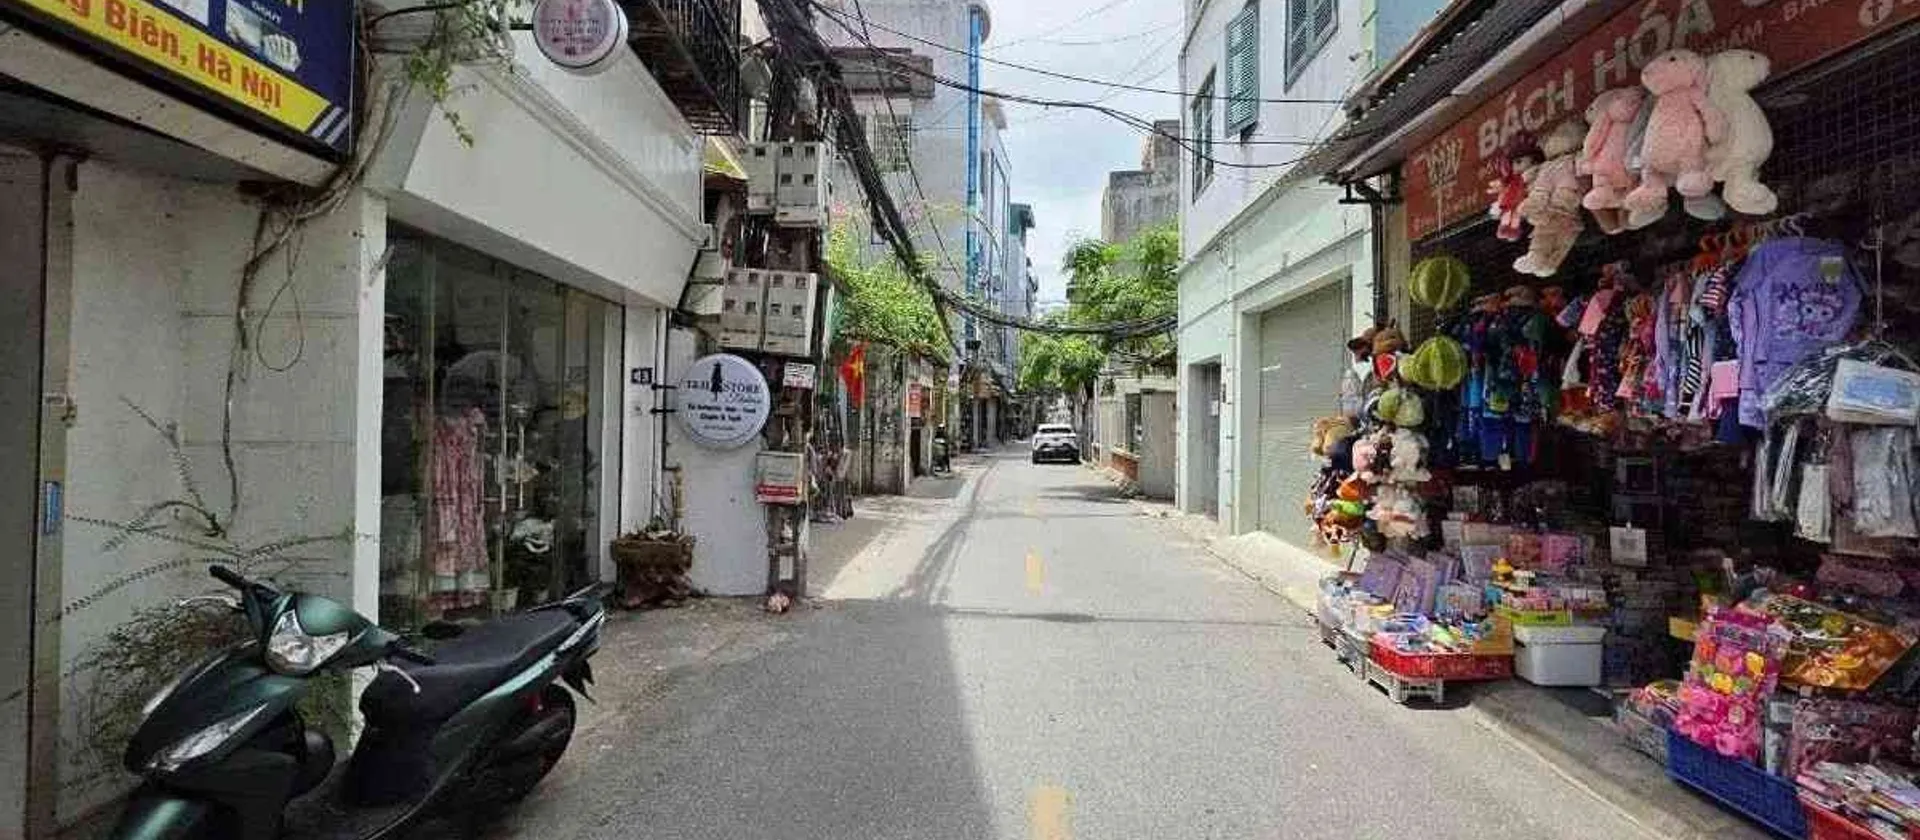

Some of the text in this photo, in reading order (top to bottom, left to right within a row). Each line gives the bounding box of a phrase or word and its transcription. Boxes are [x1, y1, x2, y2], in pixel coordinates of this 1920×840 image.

[197, 42, 232, 85] Hà
[241, 63, 283, 111] Nội
[1478, 0, 1716, 159] BÁCH HÓA
[722, 379, 760, 394] STORE
